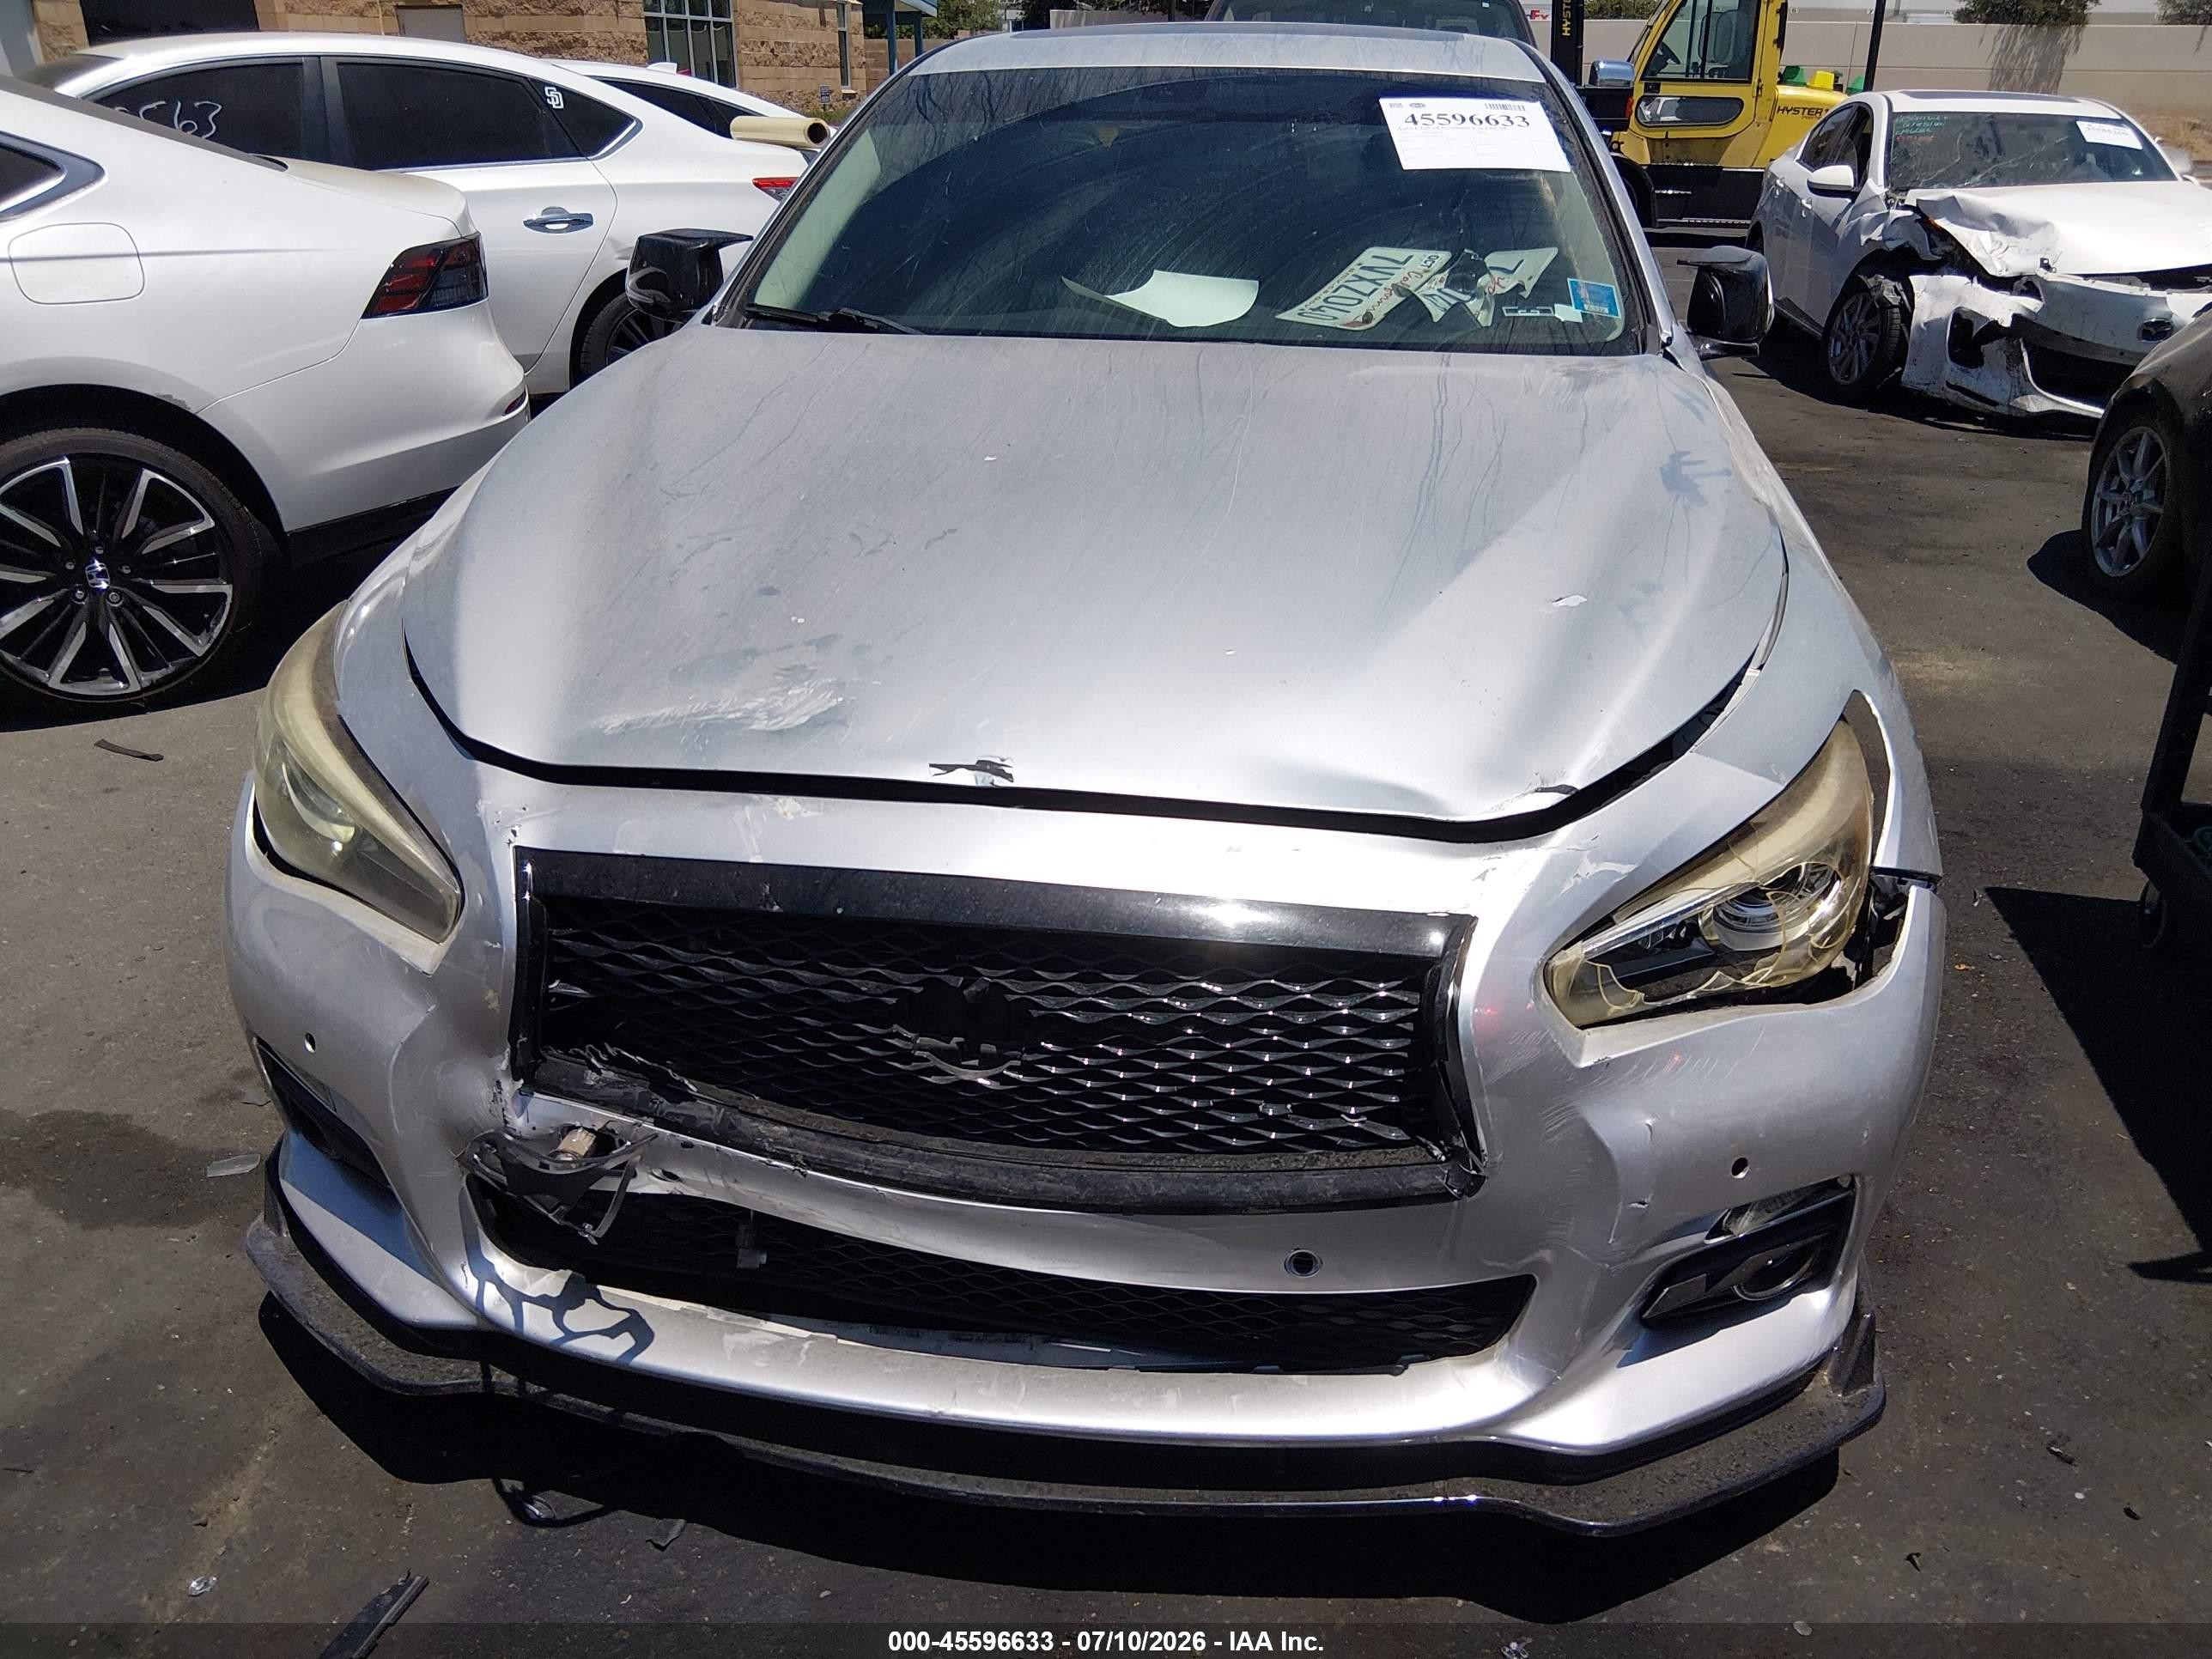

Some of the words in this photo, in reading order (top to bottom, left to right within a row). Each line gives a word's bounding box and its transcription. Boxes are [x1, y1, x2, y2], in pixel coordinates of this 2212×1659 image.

[1776, 106, 1824, 117] HYSTER
[1404, 112, 1530, 128] 45596633
[1421, 255, 1440, 269] OCT
[1297, 254, 1414, 321] 7VXZ040
